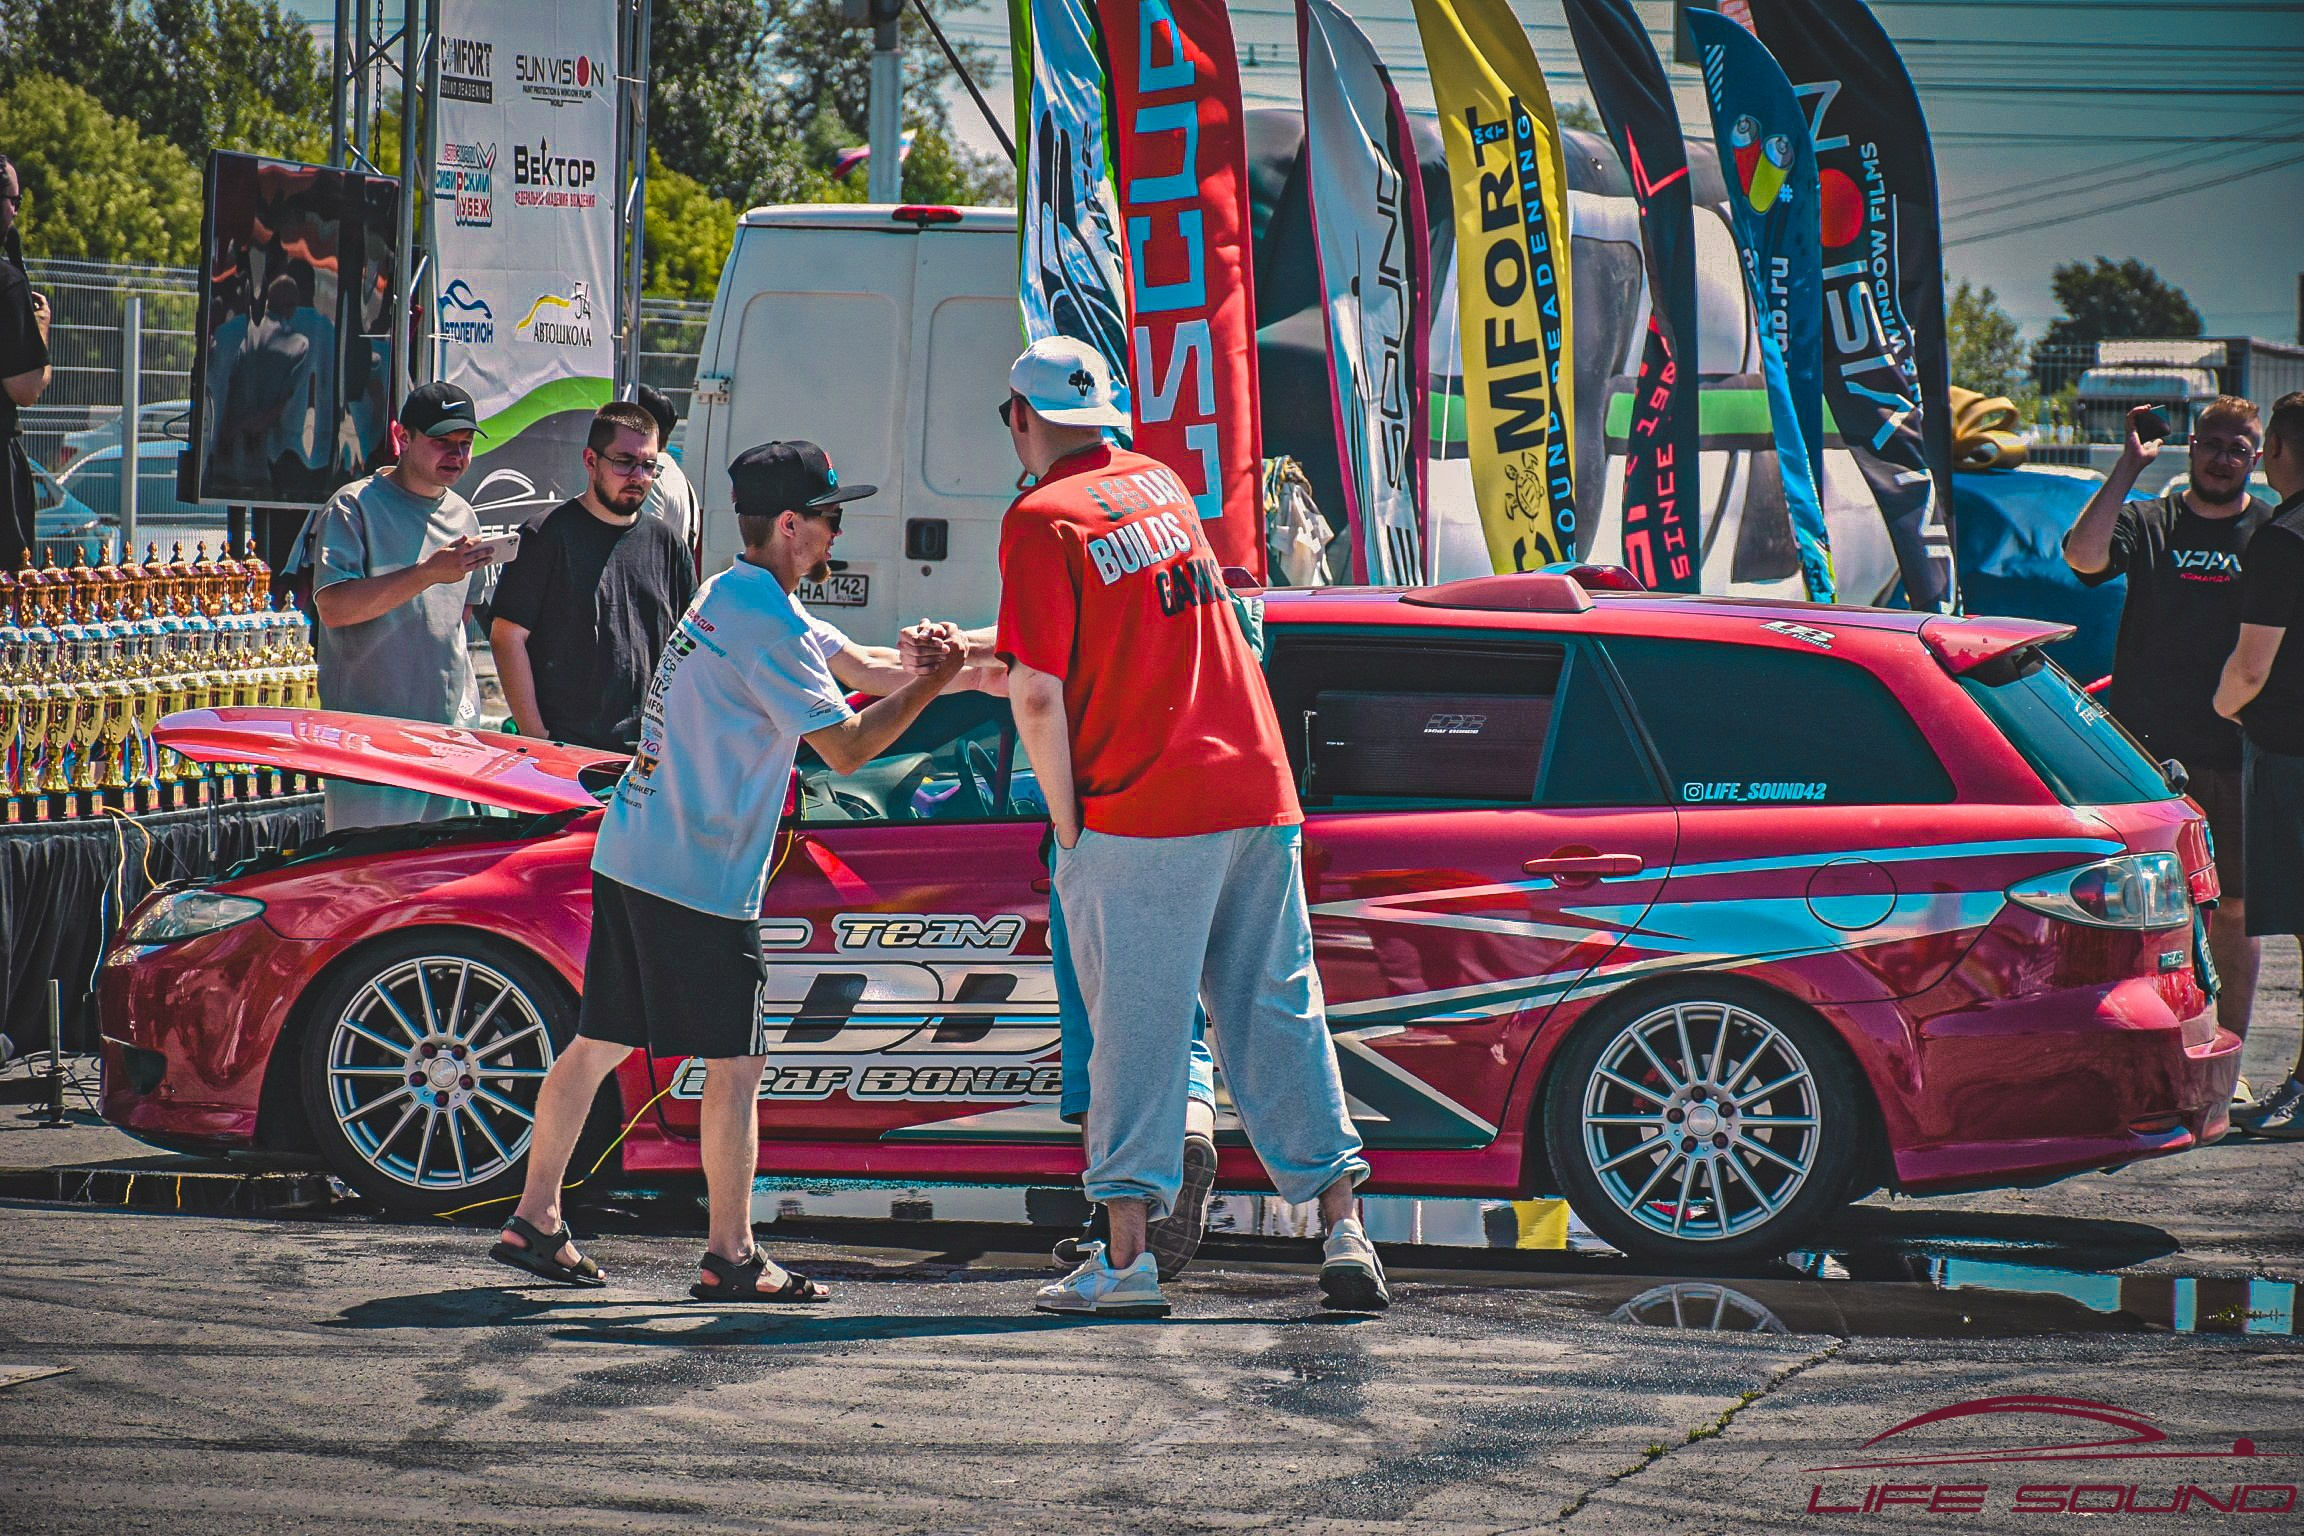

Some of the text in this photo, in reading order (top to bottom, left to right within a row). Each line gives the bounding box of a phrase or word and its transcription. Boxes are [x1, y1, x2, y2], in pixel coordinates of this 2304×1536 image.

[516, 55, 604, 88] SUN VISION
[1473, 125, 1506, 147] MAT
[1861, 141, 1888, 221] FILMS
[1870, 231, 1905, 354] WINDOW
[533, 322, 592, 348] АВТОШКОЛА
[1656, 443, 1692, 580] SINCE
[1087, 512, 1191, 586] BUILDS
[830, 577, 861, 595] 142
[697, 618, 715, 632] CUP
[1704, 783, 1827, 801] LIFE_SOUND42
